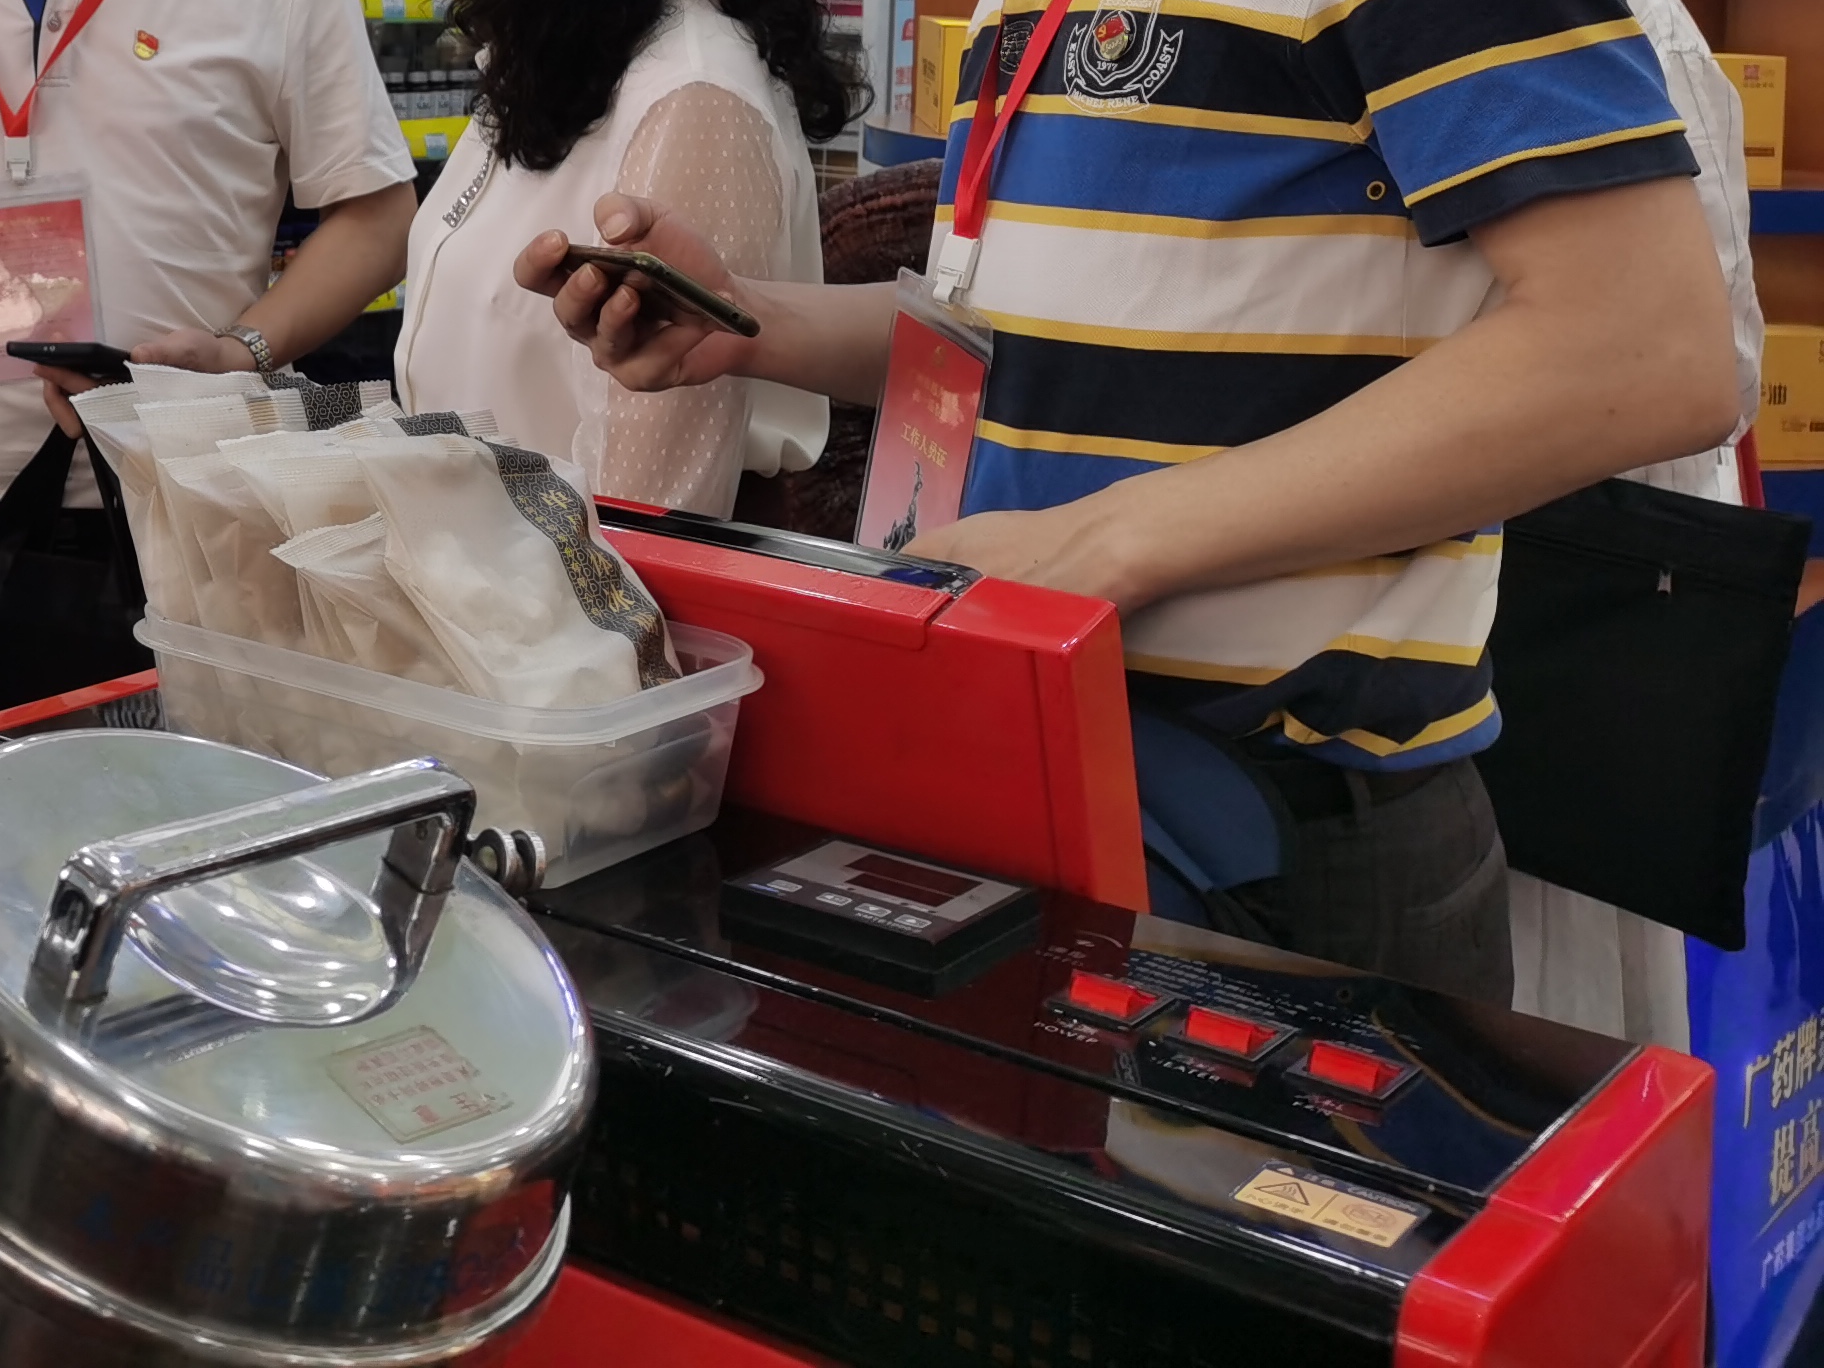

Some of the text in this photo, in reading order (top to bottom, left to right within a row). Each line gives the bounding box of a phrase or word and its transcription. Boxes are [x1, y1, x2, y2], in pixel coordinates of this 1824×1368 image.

[1097, 61, 1118, 72] 1977
[1143, 44, 1175, 88] COAST
[1071, 89, 1140, 109] MICHEL RENE
[900, 422, 948, 468] 工作人员证
[1033, 1022, 1099, 1044] POWER
[1743, 1008, 1824, 1129] 广药牌
[1292, 1099, 1334, 1117] FAN
